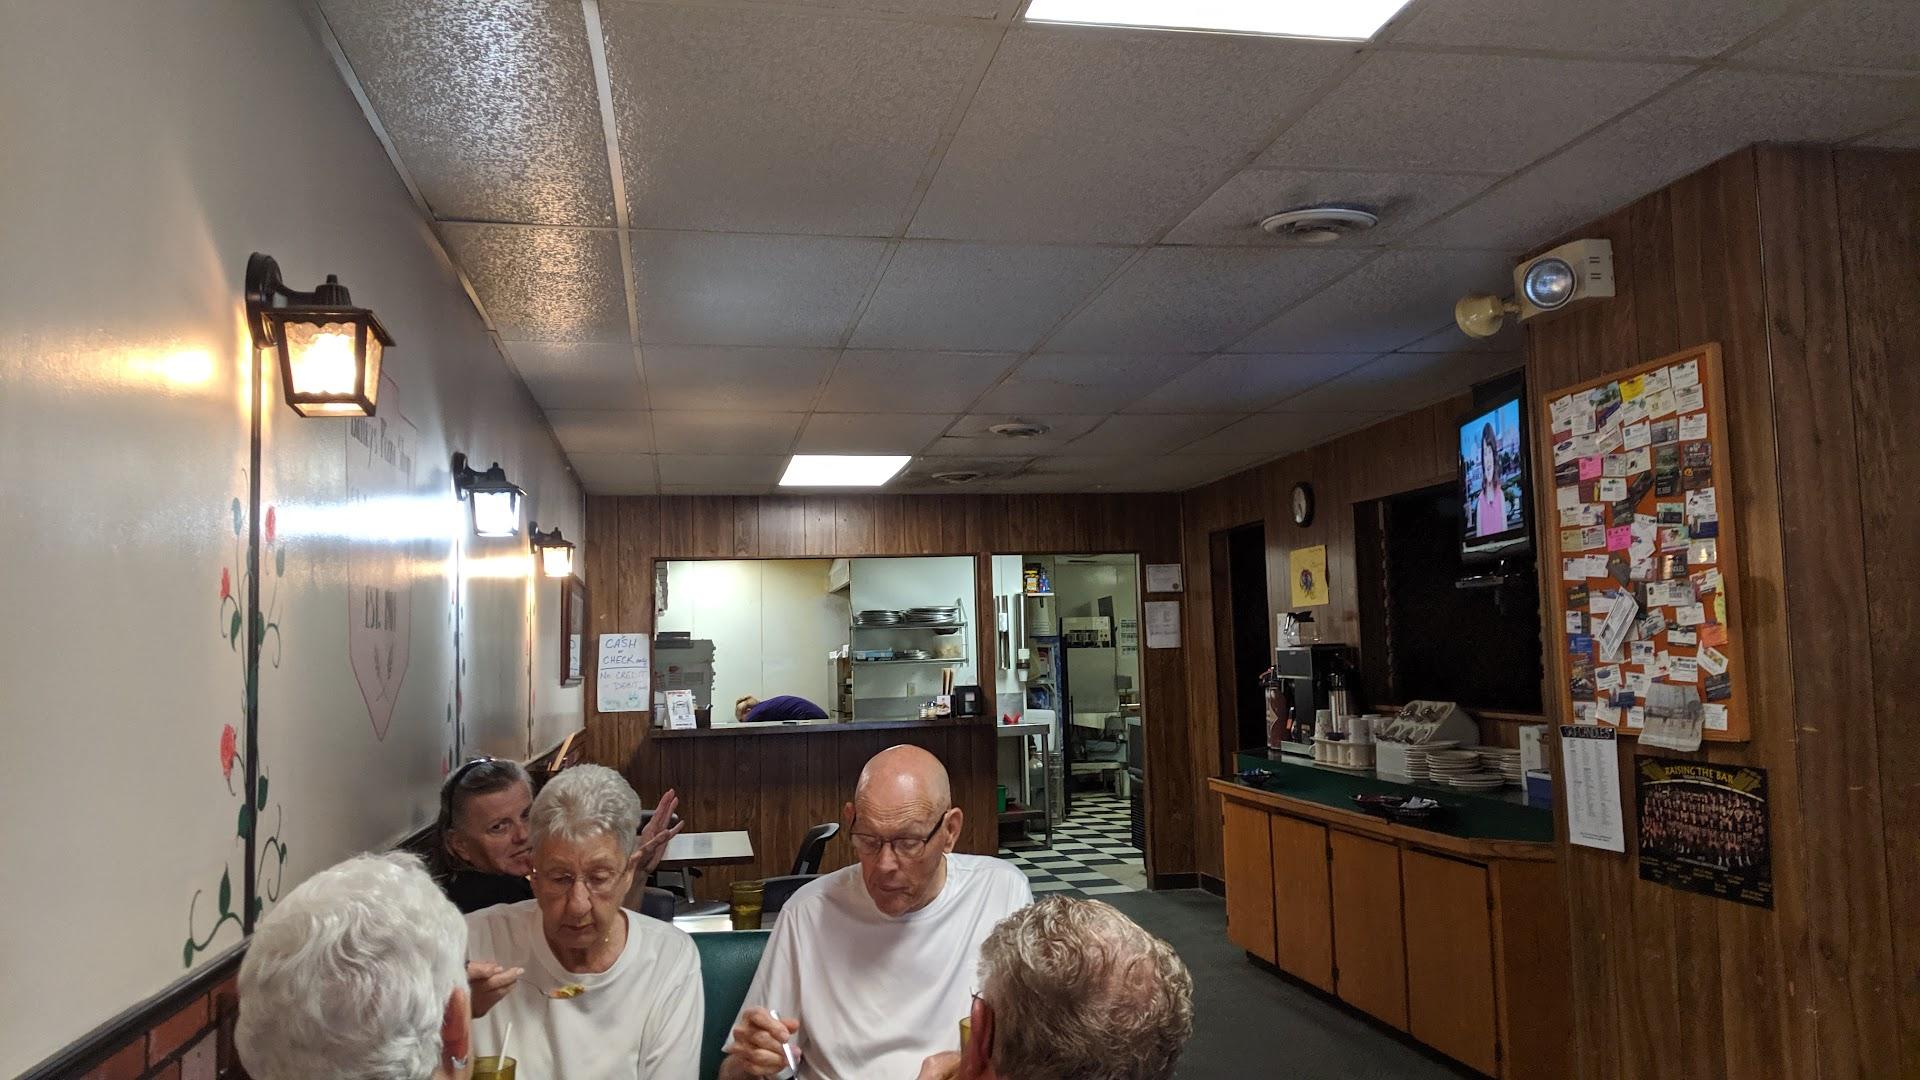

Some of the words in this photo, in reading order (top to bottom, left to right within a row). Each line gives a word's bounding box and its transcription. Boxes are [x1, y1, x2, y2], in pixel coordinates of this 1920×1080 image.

[605, 638, 637, 648] CASH
[603, 654, 635, 664] CHECK
[1664, 766, 1696, 776] RAISING
[1695, 767, 1715, 778] THE
[1716, 771, 1735, 784] BAR
